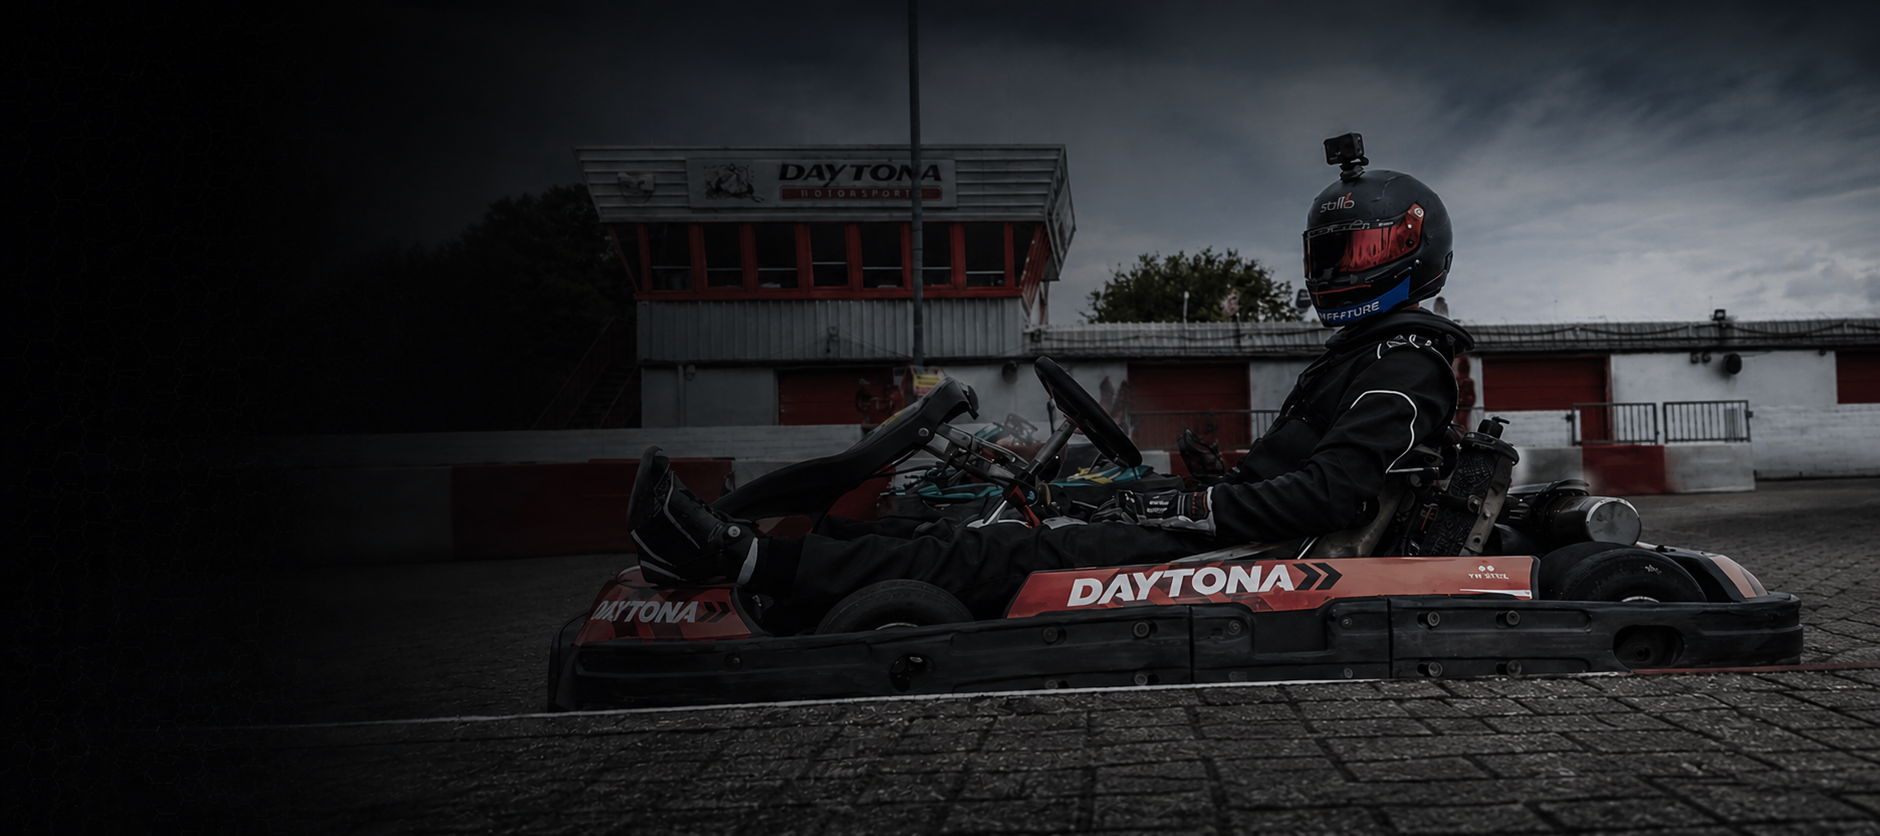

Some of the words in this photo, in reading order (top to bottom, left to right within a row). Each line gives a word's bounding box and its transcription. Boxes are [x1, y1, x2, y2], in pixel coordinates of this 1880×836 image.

[778, 163, 942, 188] DAYTONA
[1066, 564, 1295, 607] DAYTONA
[590, 600, 699, 623] DAYTONA
